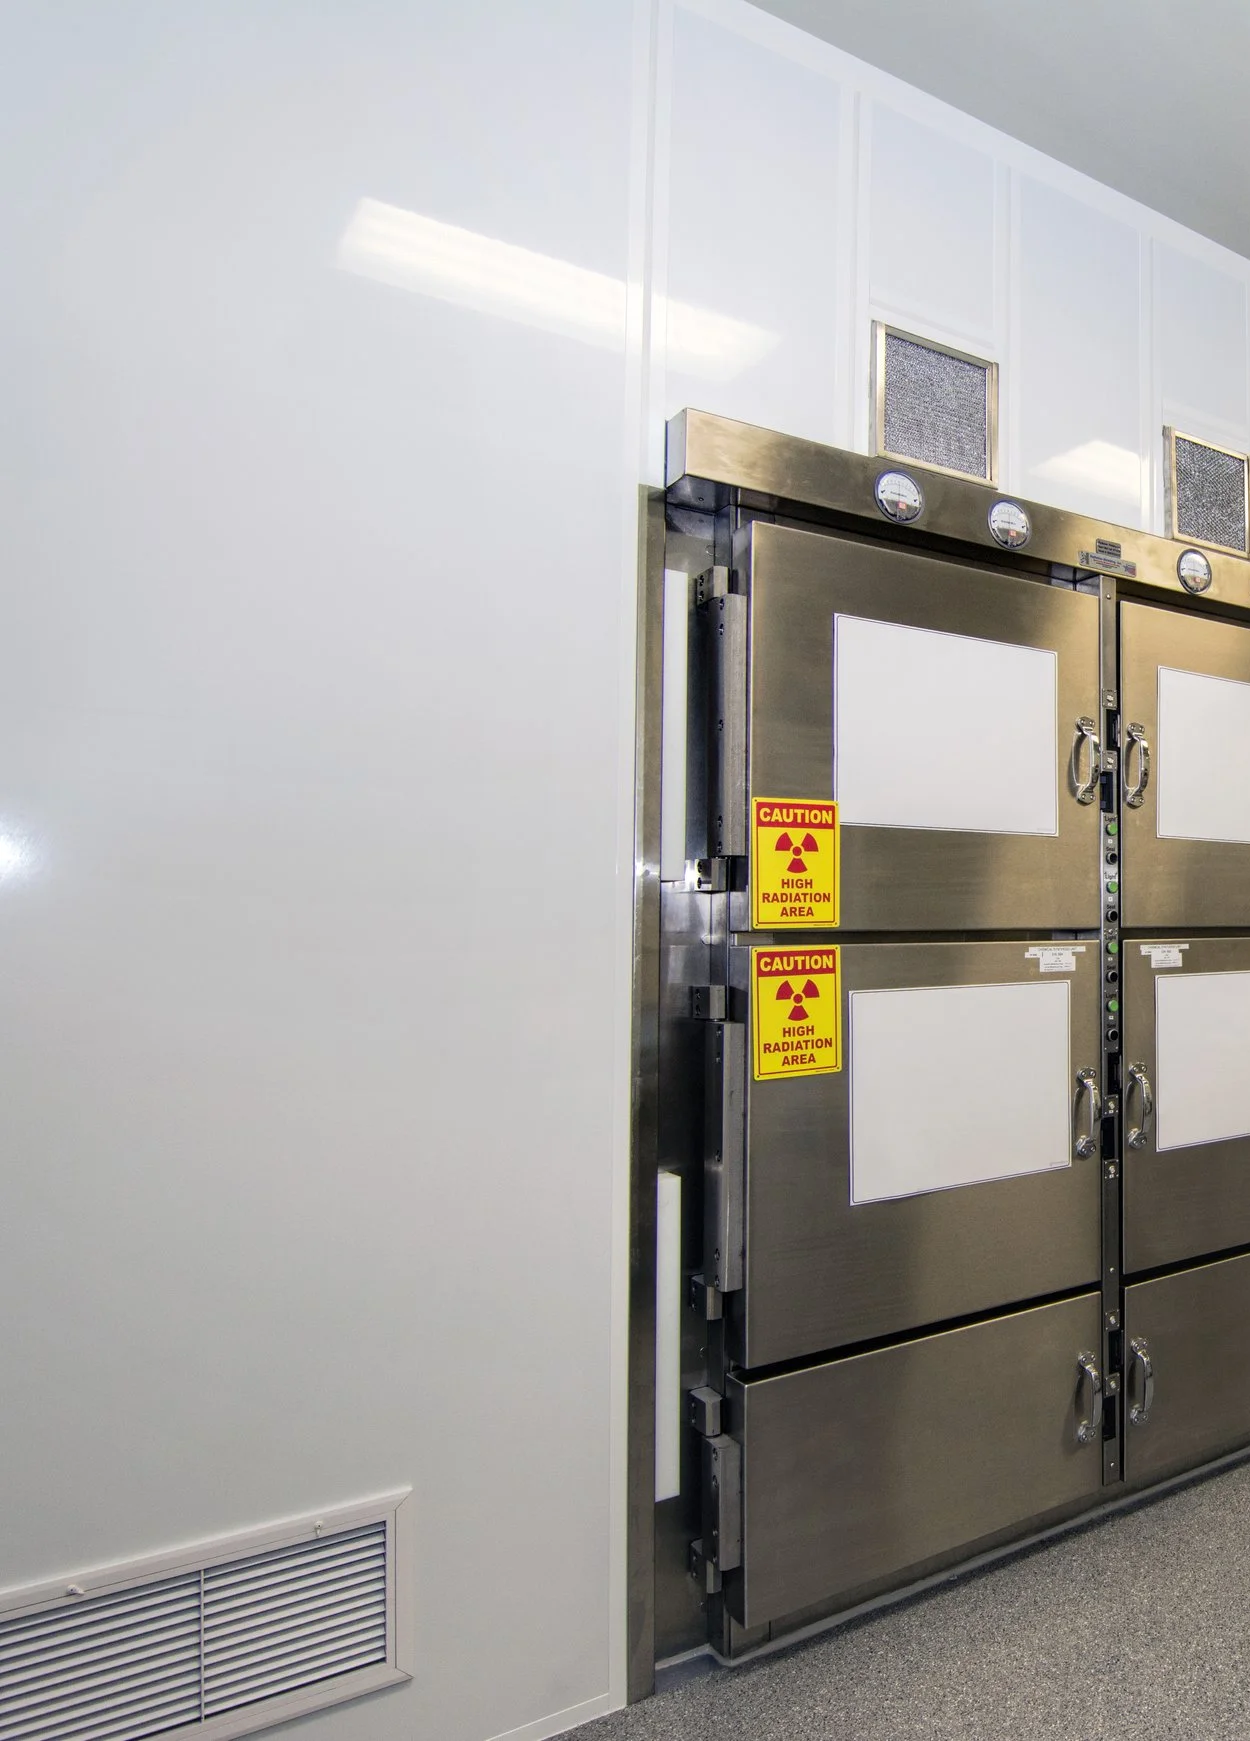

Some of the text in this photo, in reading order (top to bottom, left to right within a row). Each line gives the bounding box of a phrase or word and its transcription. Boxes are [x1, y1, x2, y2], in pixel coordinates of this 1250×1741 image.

[759, 808, 832, 824] CAUTION
[781, 879, 813, 889] HIGH
[762, 892, 830, 903] RADIATION
[780, 907, 814, 917] AREA
[760, 955, 833, 972] CAUTION
[783, 1025, 815, 1037] HIGH
[763, 1038, 832, 1054] RADIATION
[782, 1053, 816, 1066] AREA
